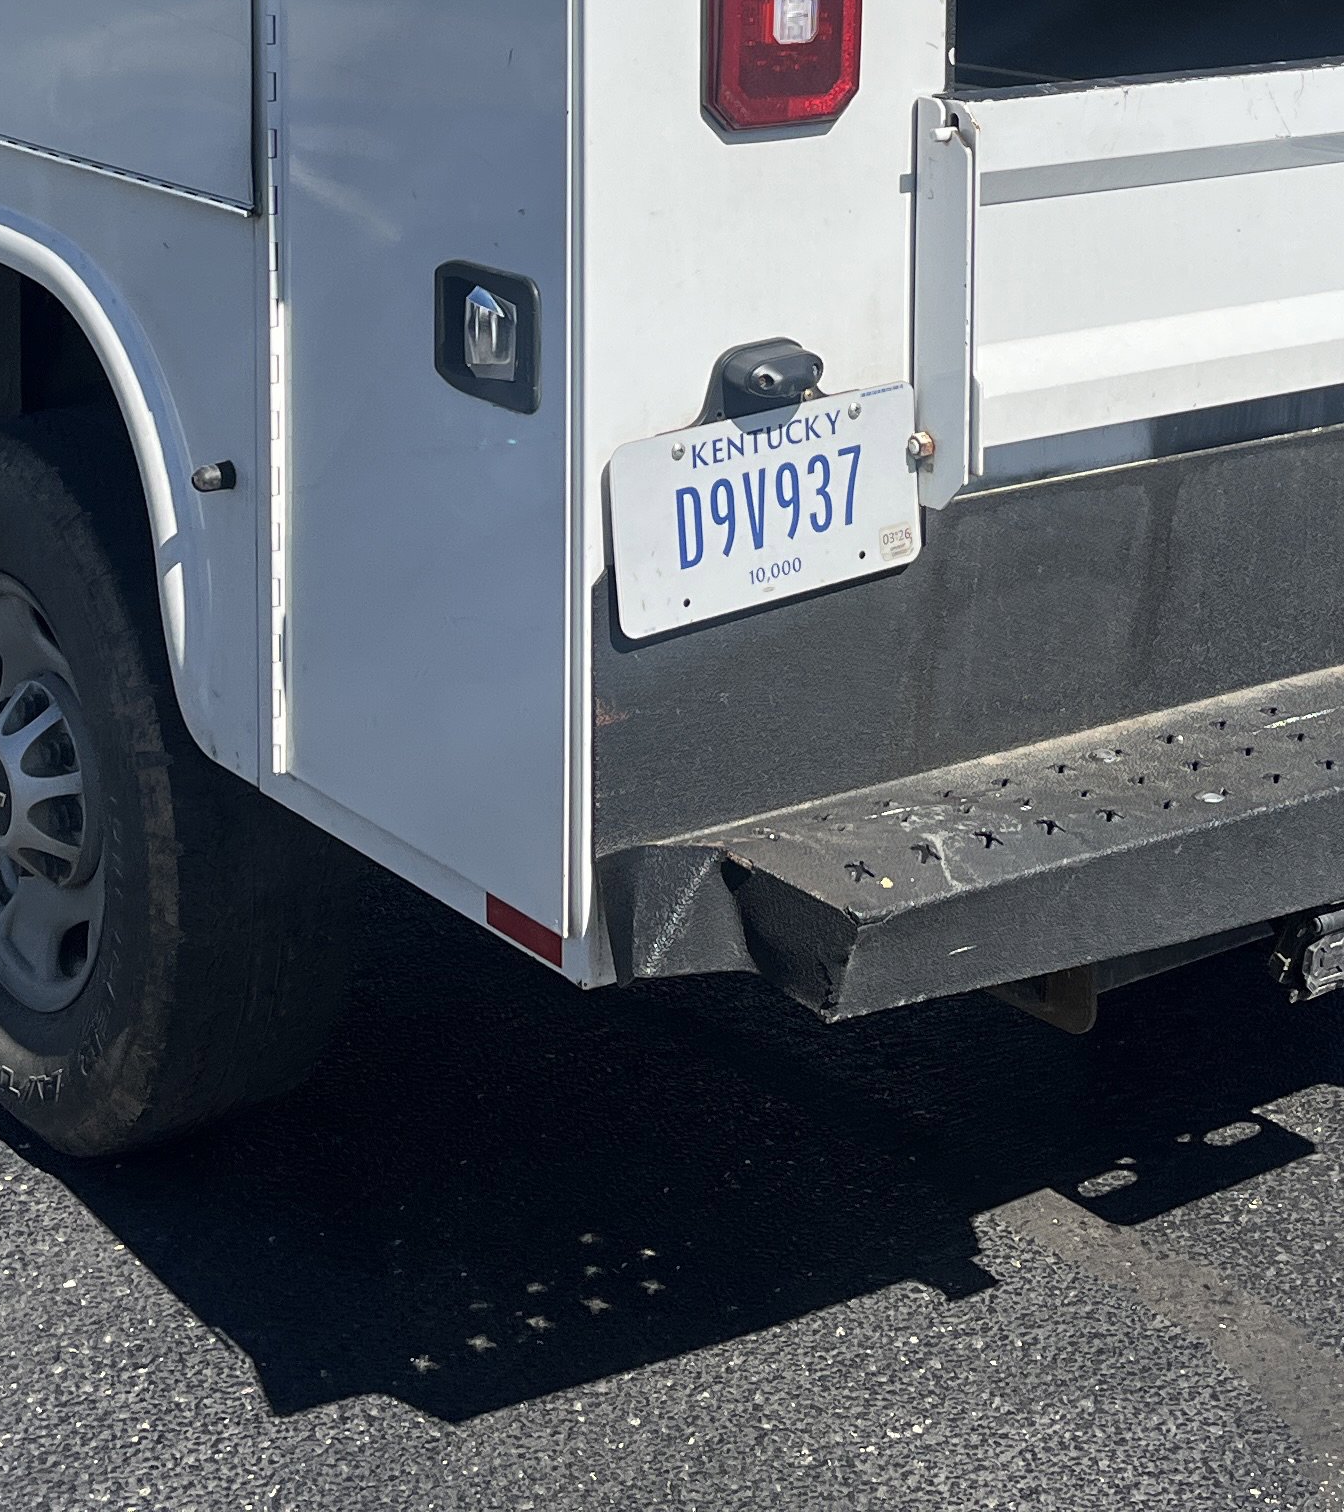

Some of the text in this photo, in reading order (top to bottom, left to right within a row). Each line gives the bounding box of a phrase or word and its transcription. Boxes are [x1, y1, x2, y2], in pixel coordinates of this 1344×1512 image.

[691, 410, 841, 469] KENTUCKY
[675, 444, 862, 570] D9V937
[749, 557, 802, 584] 10,000
